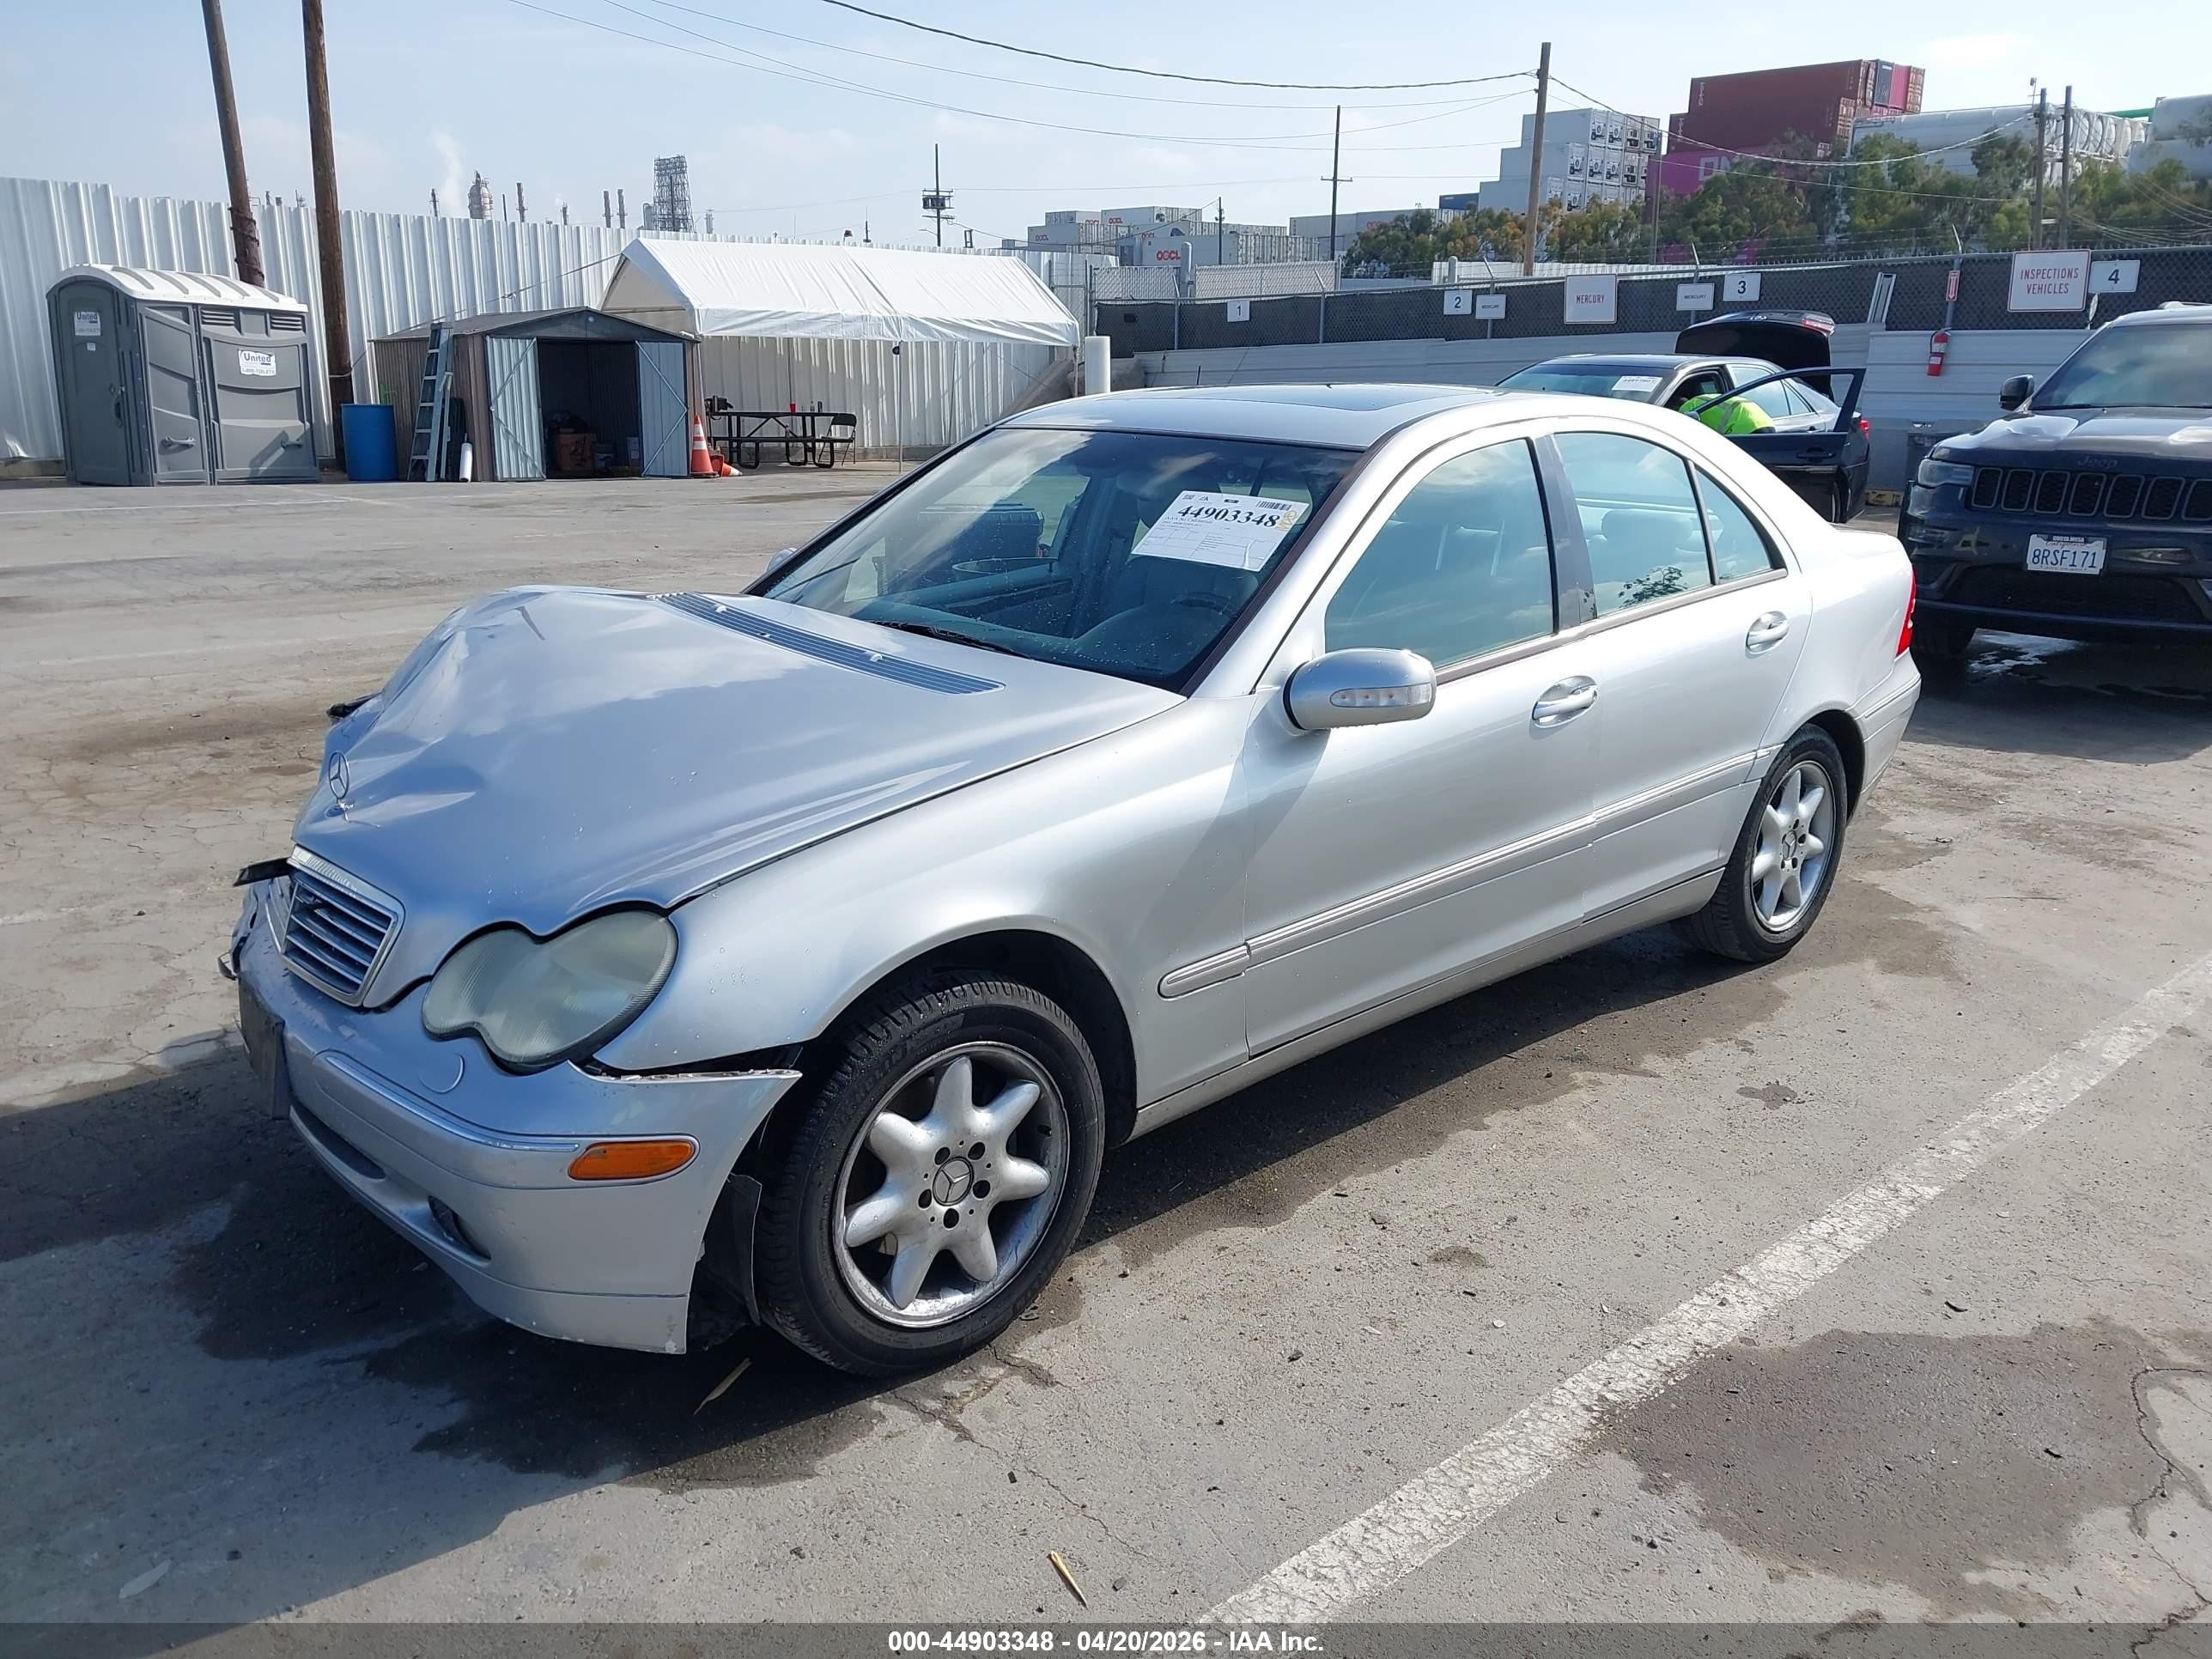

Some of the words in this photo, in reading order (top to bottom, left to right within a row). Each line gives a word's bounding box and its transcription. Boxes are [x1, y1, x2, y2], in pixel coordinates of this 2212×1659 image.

[1156, 250, 1182, 260] OOCL
[2021, 267, 2080, 280] INSPECTIONS
[2108, 269, 2120, 284] 4
[1737, 280, 1747, 294] 3
[2027, 283, 2070, 295] VEHICLES
[1454, 295, 1462, 308] 2
[1576, 294, 1606, 304] MERCURY
[1237, 304, 1242, 317] 1
[243, 352, 271, 362] United
[2077, 455, 2118, 469] Jeep
[1176, 505, 1281, 528] 44903348
[2032, 549, 2097, 568] 8RSF171
